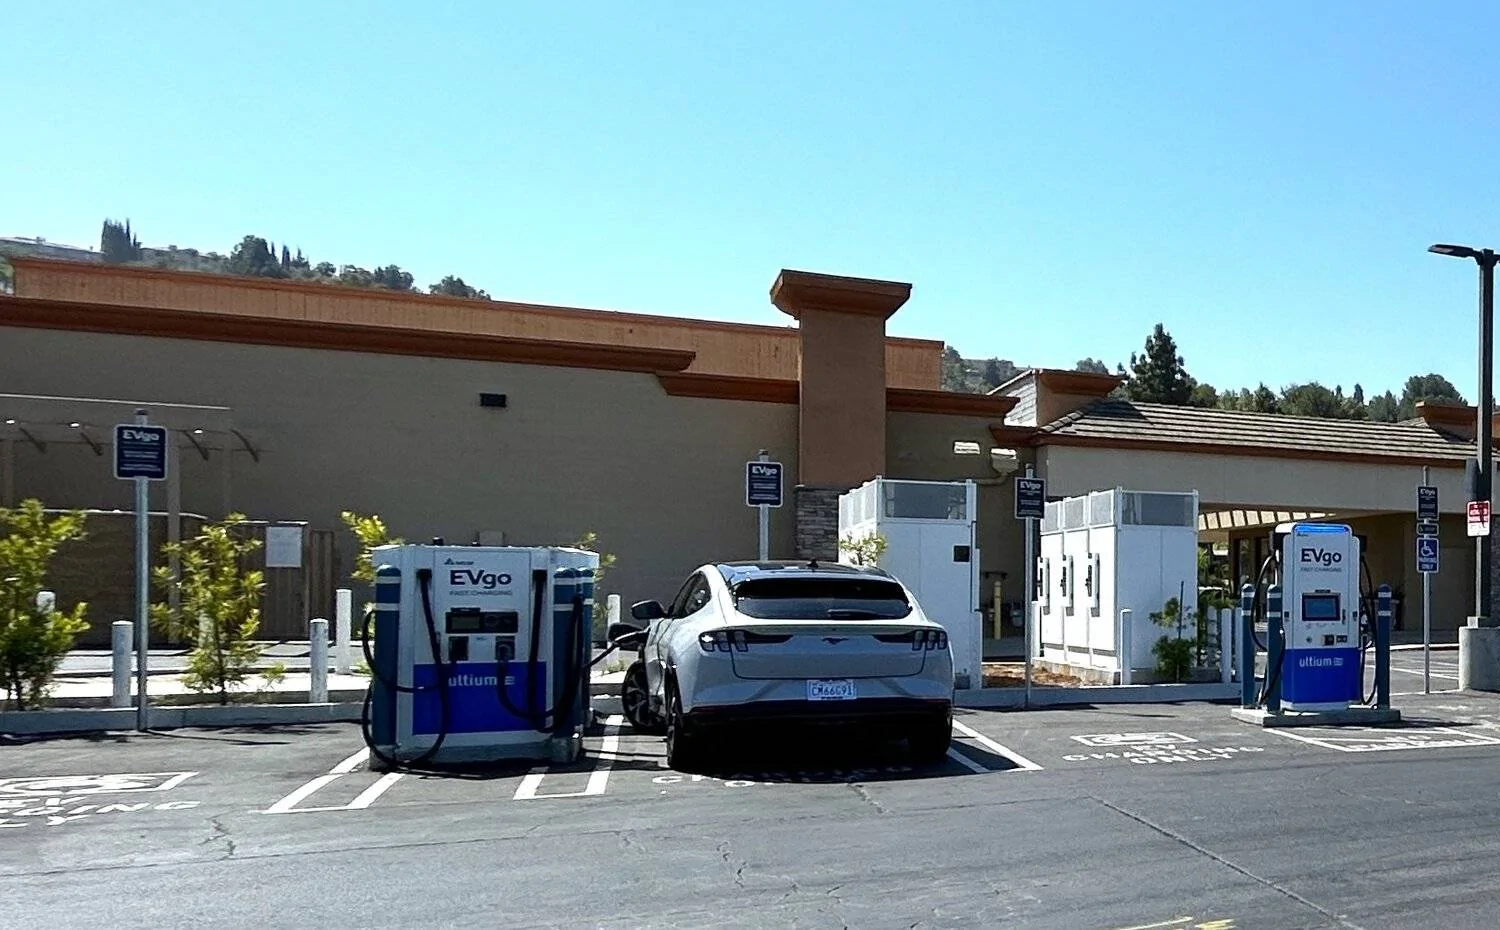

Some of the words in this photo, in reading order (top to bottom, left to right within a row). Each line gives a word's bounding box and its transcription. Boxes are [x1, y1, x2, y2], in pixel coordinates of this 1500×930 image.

[122, 429, 160, 442] EVgo
[1301, 548, 1342, 566] EVgo
[450, 570, 512, 590] EVgo
[1299, 656, 1332, 667] ultium
[448, 674, 497, 687] ultium
